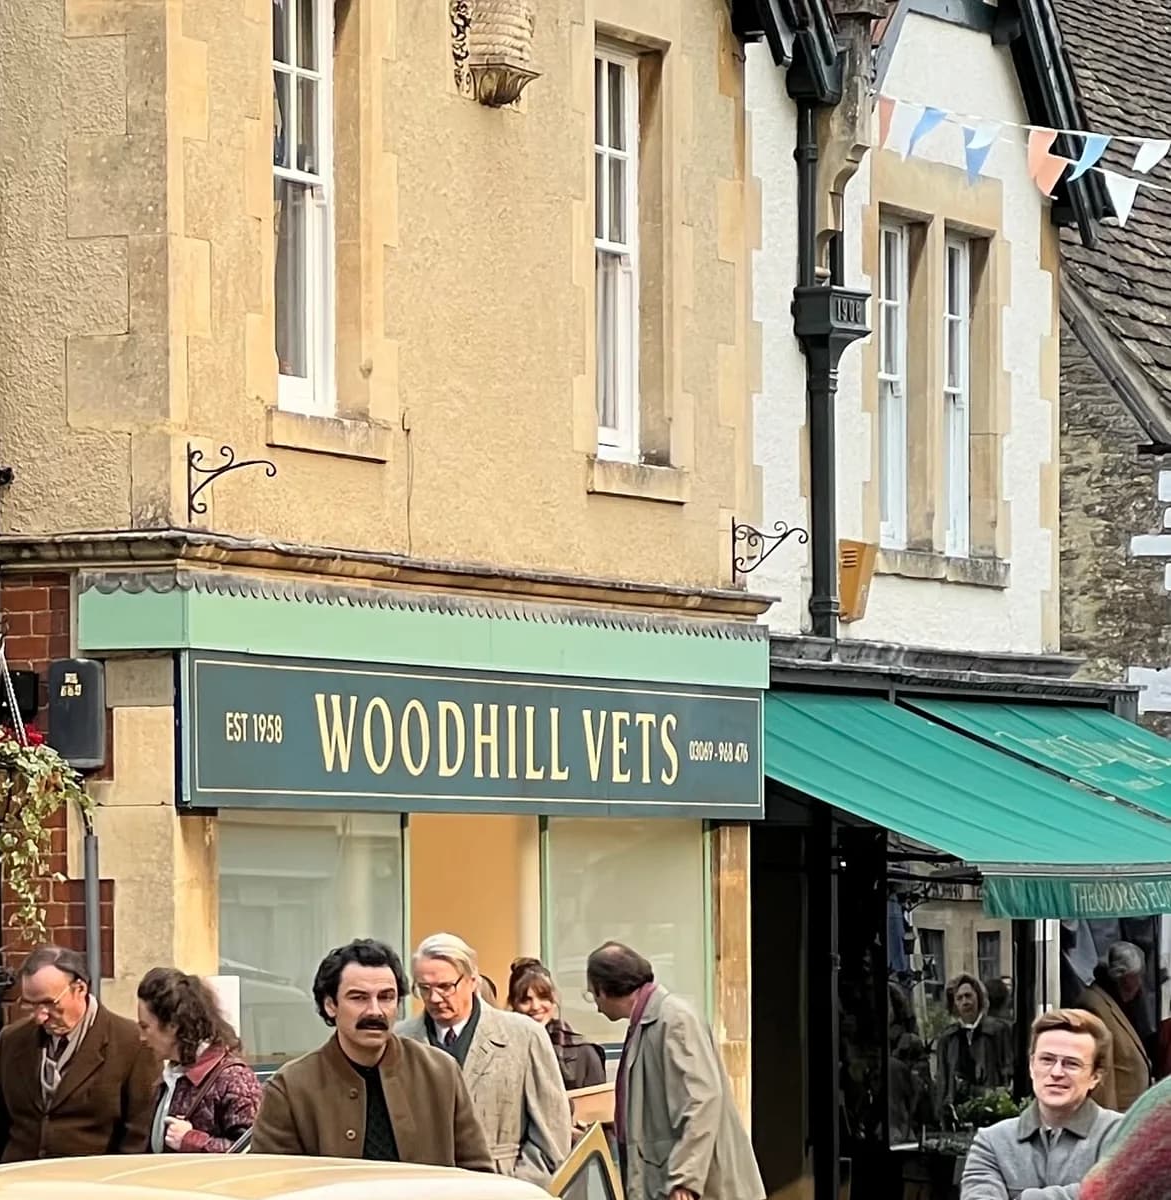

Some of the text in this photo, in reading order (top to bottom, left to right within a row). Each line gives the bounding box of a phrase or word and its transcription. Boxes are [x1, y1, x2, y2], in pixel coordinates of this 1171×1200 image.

[225, 711, 283, 744] EST 1958
[314, 692, 680, 786] WOODHILL VETS
[734, 742, 749, 763] 476
